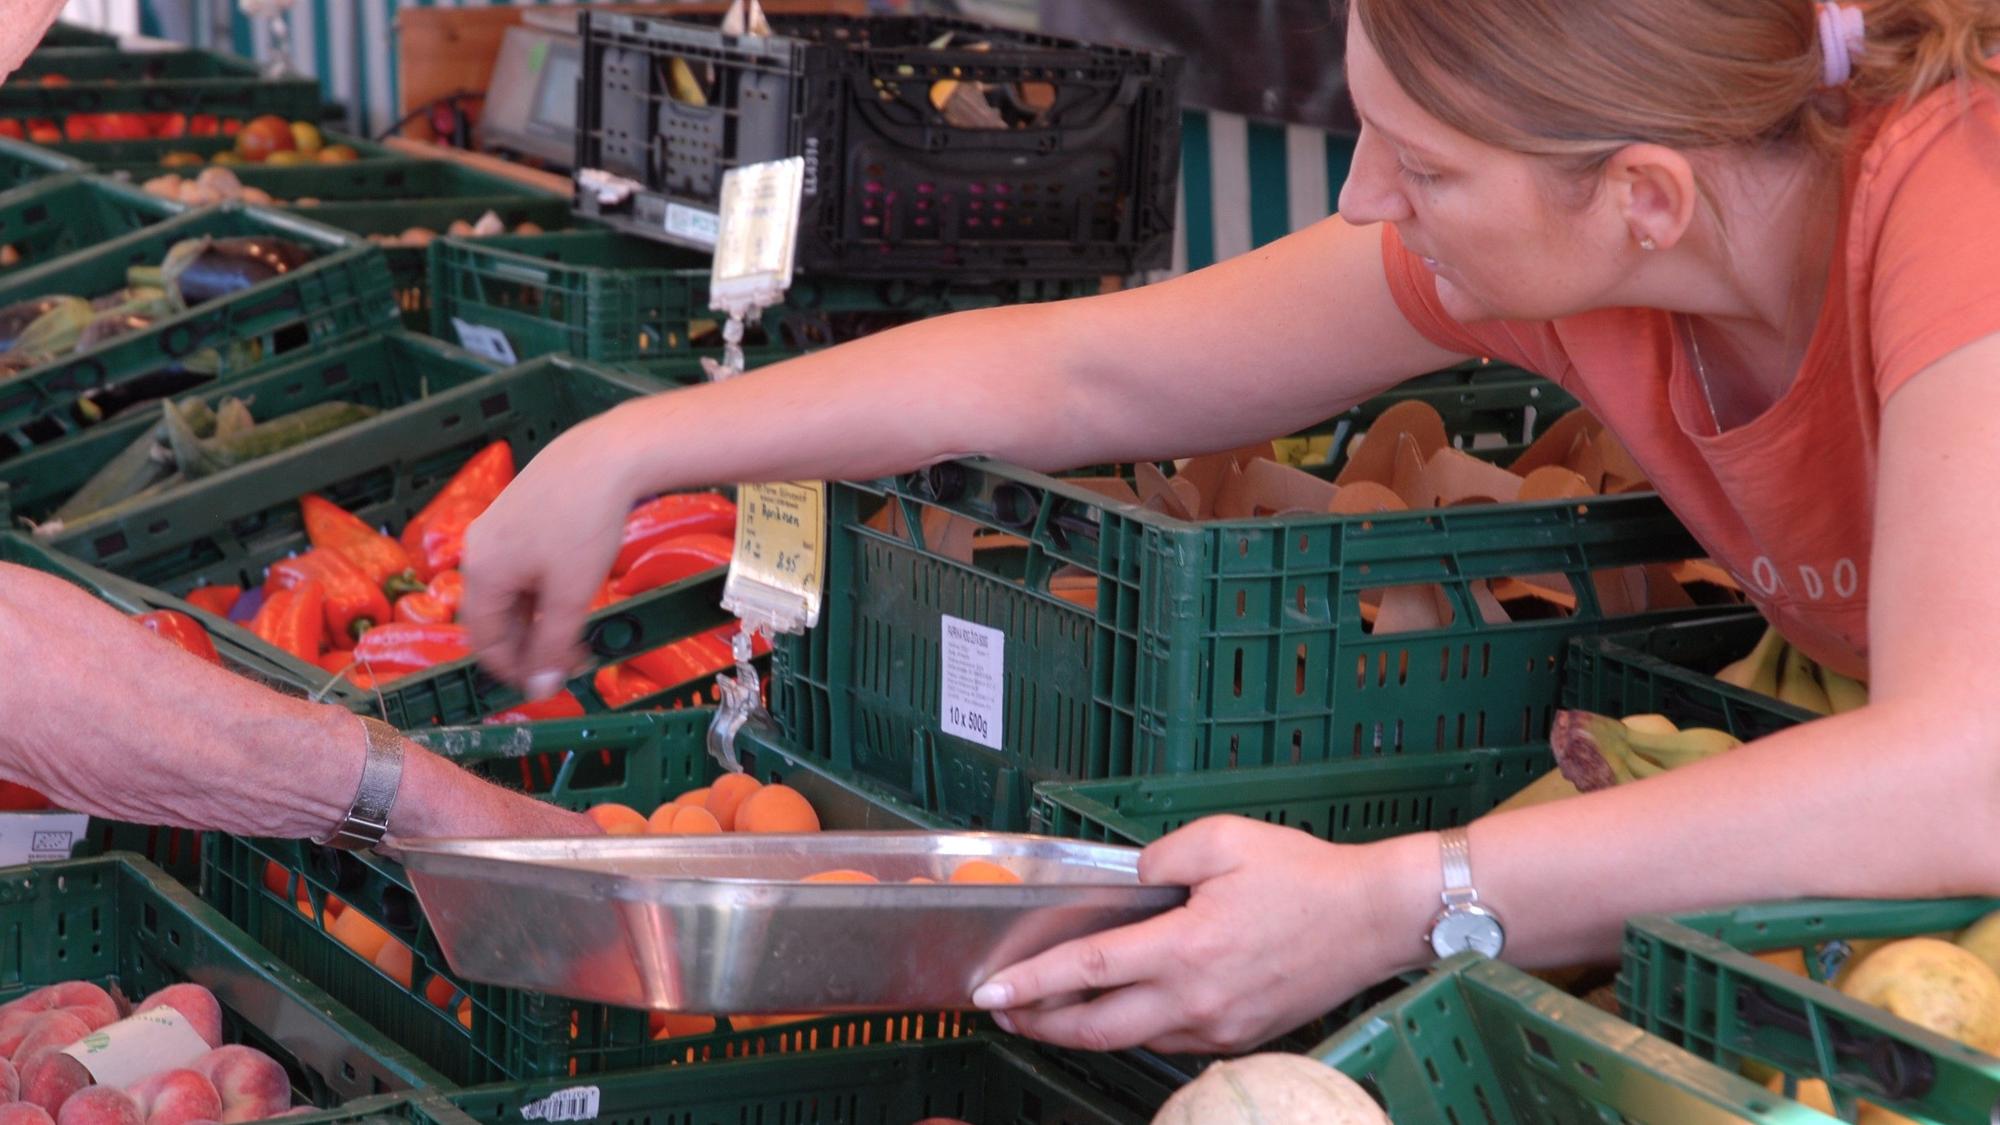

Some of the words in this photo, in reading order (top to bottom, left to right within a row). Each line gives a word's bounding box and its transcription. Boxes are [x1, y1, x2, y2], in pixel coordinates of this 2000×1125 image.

[950, 705, 960, 726] 10
[961, 713, 966, 729] x
[968, 711, 988, 739] 500g
